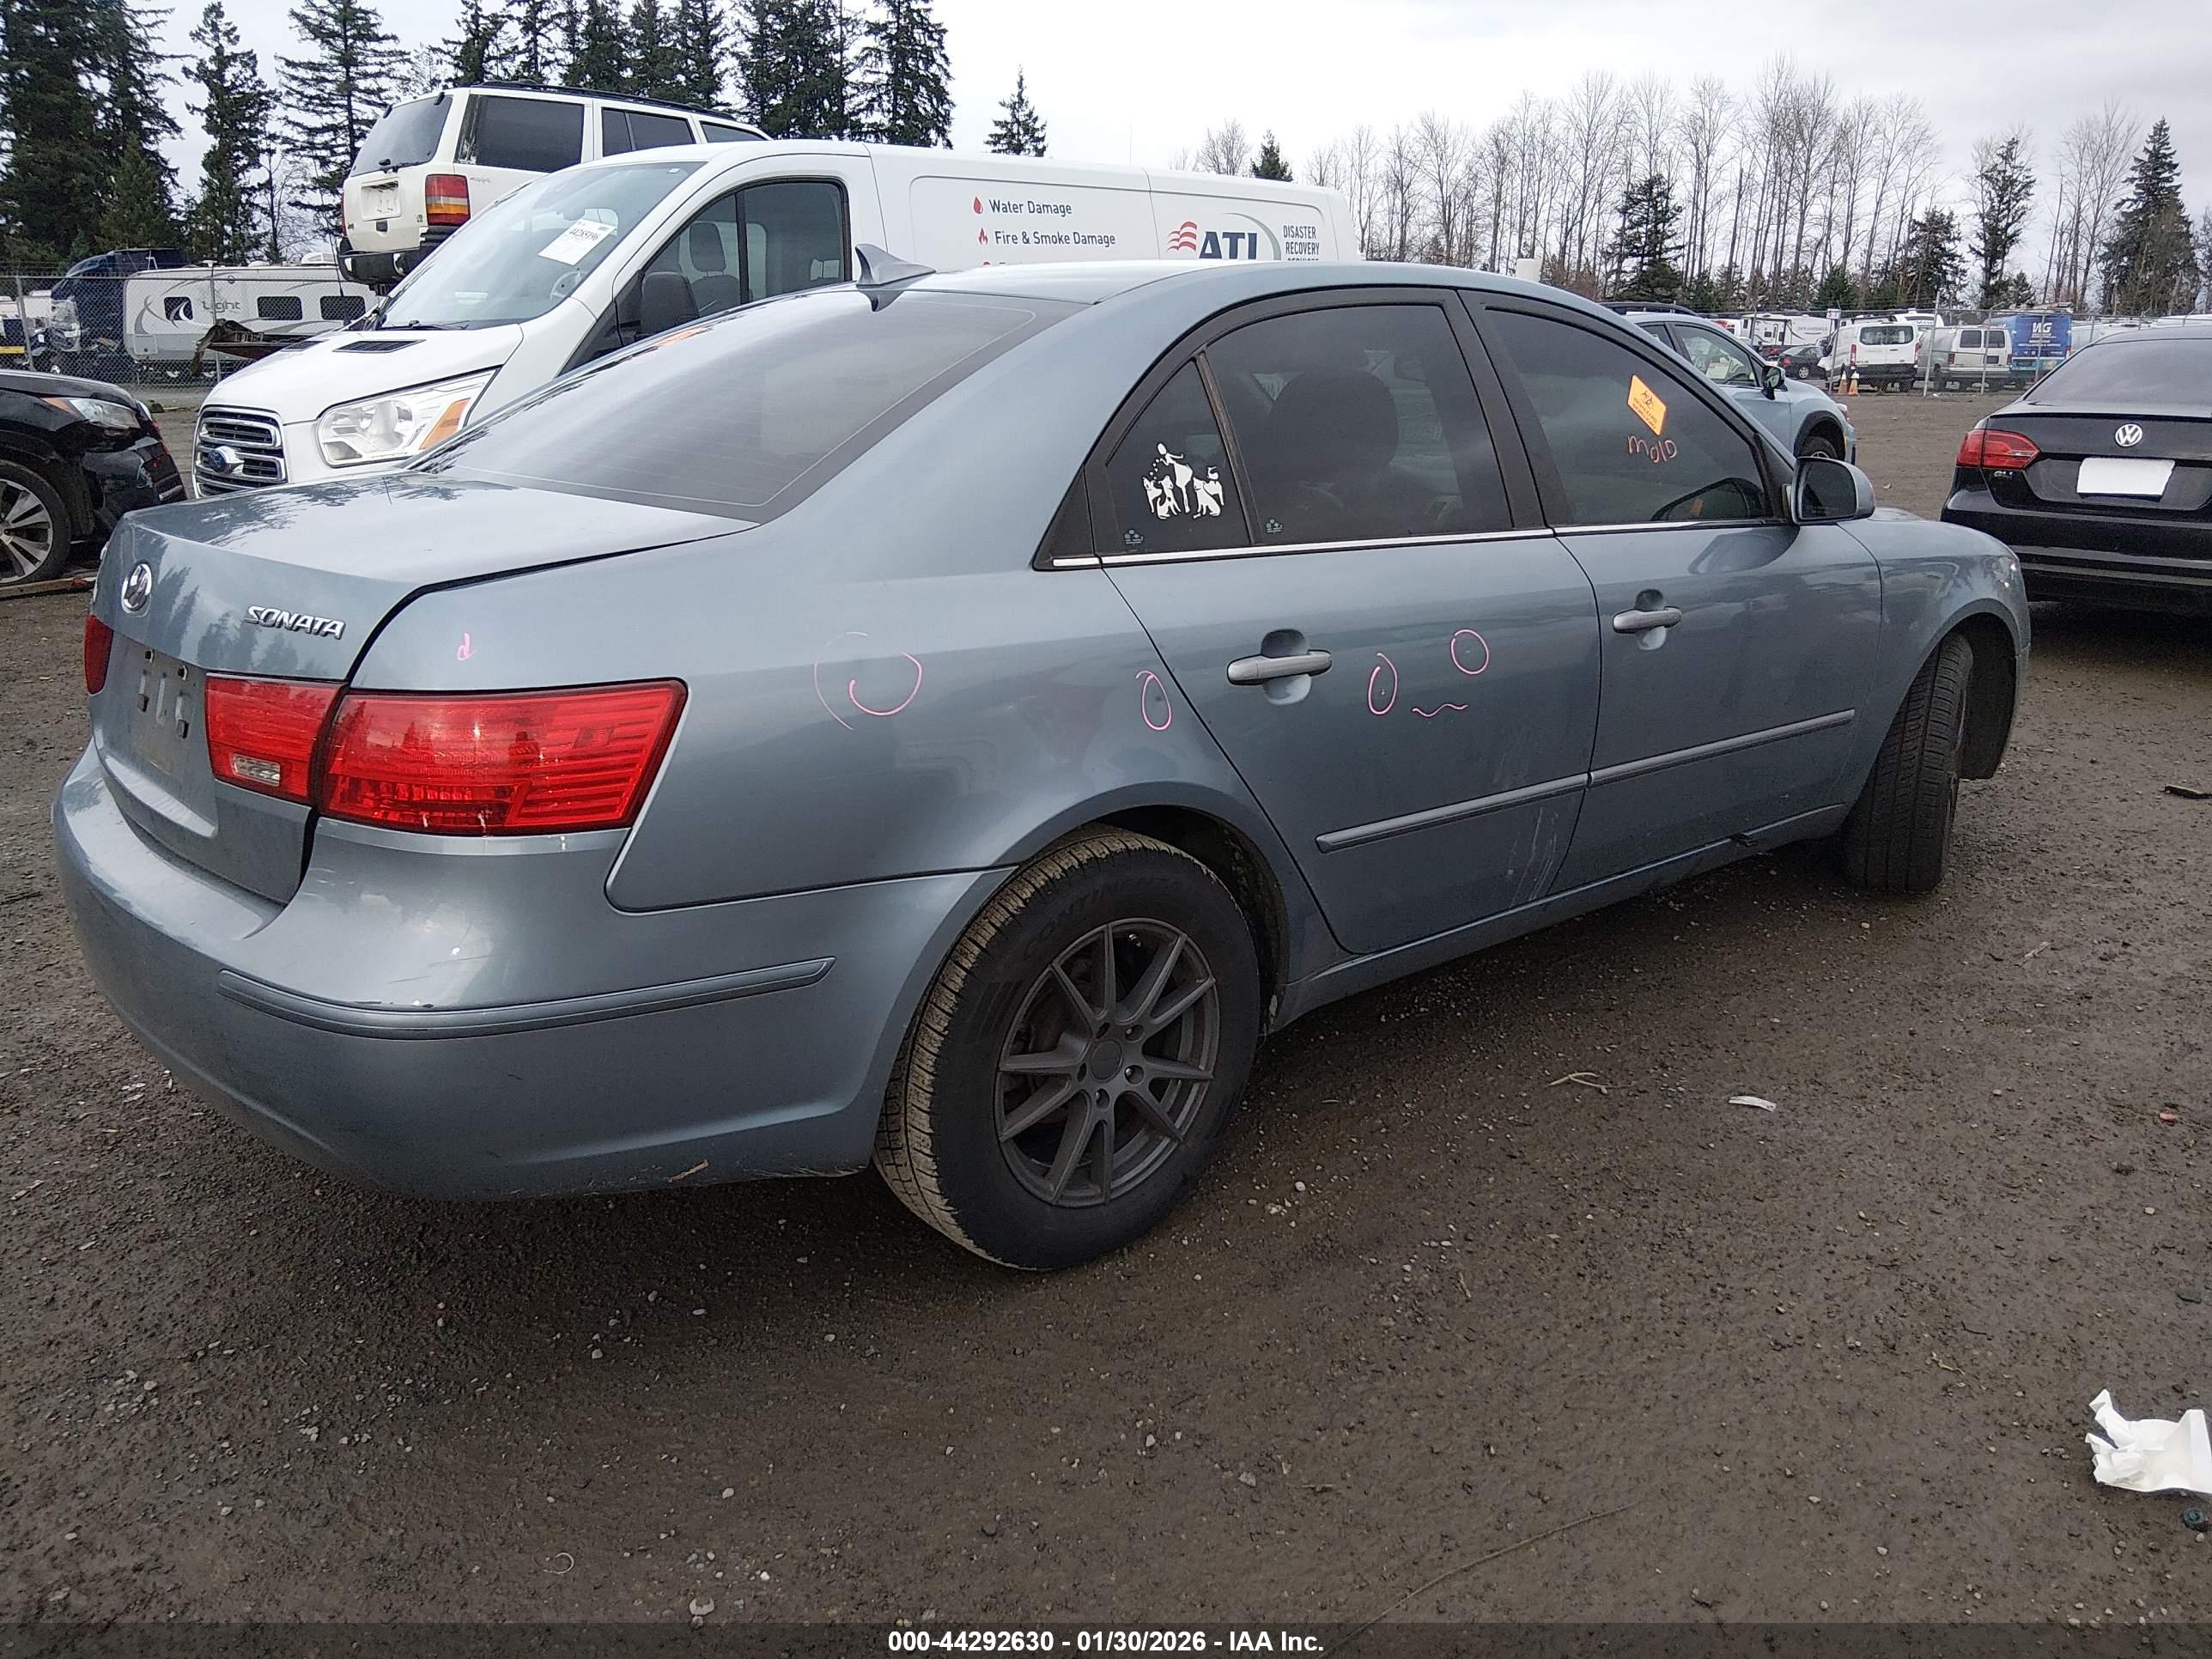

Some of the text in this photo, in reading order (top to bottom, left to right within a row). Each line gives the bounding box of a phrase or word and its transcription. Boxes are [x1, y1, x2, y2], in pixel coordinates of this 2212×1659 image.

[988, 199, 1073, 217] Water Damage
[994, 230, 1116, 248] Fire & Smoke Damage
[1283, 224, 1316, 240] DISASTER
[1198, 231, 1258, 260] ATI
[1285, 241, 1320, 255] RECOVERY
[244, 605, 346, 640] SONATA
